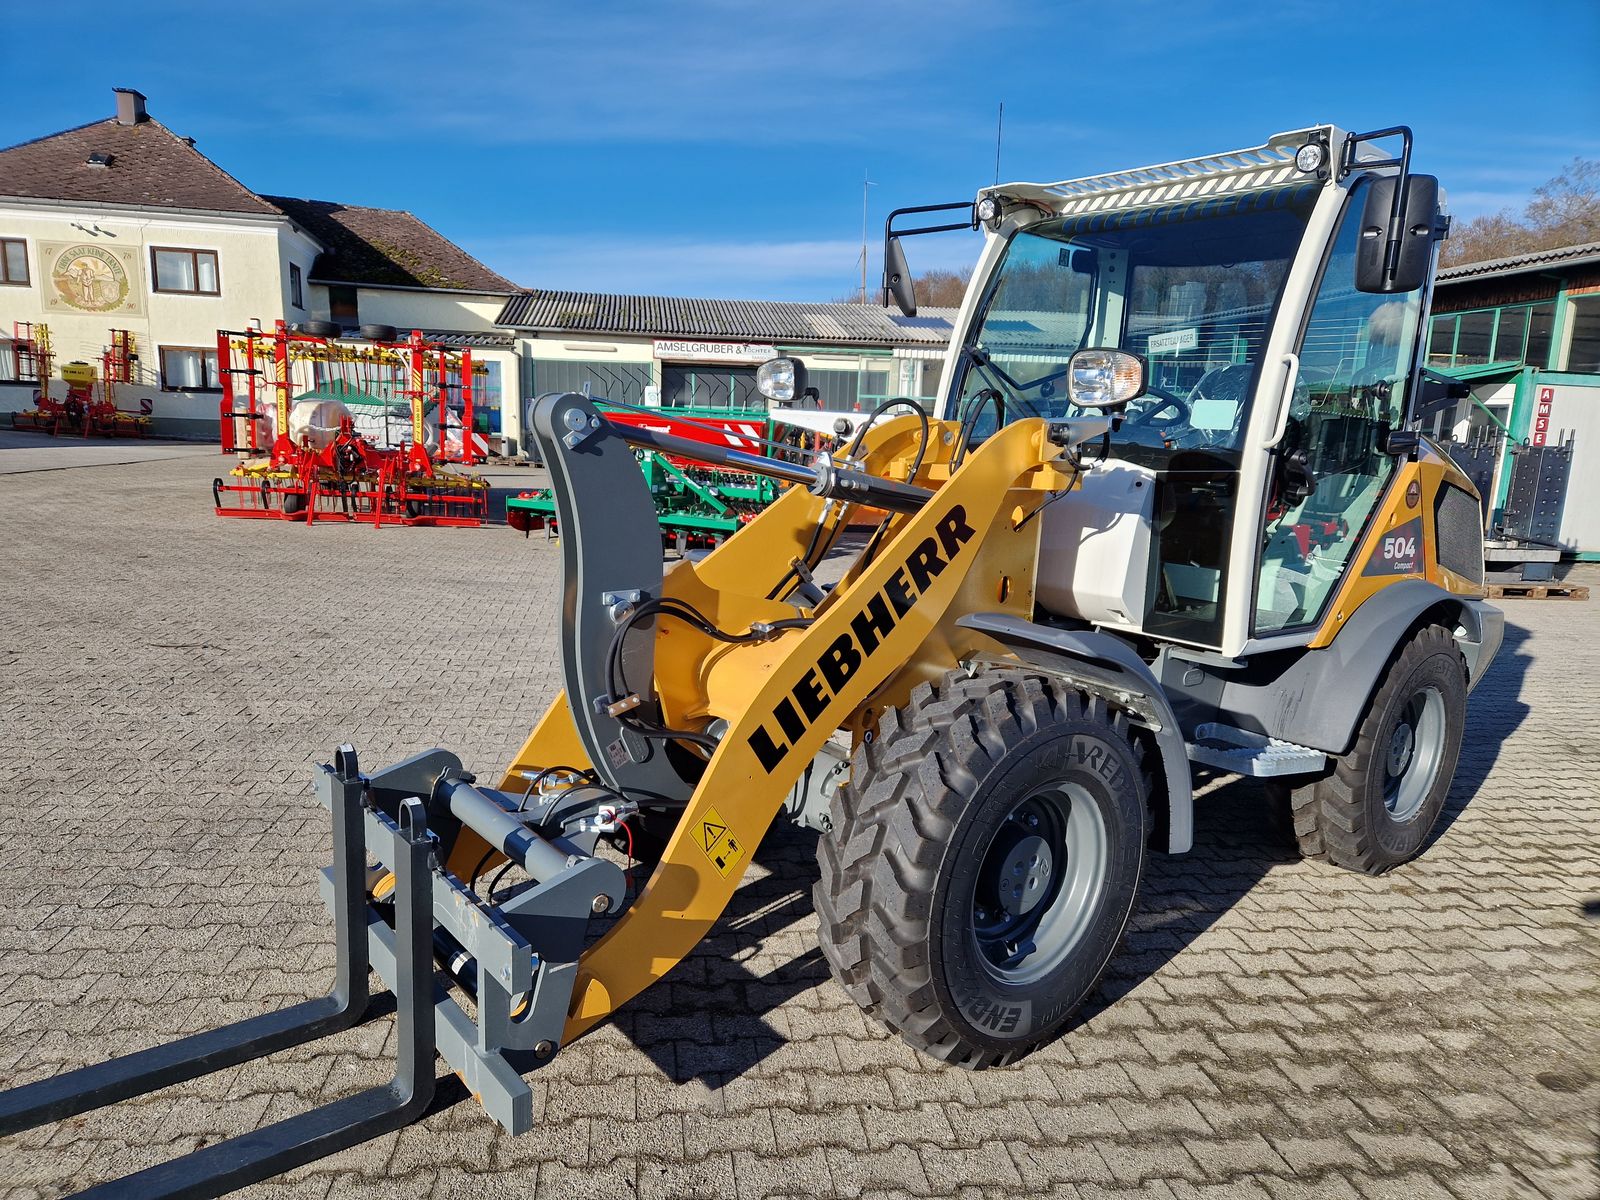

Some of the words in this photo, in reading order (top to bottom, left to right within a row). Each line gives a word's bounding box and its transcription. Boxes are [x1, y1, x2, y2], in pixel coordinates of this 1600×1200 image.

[69, 247, 86, 257] SAAT
[87, 247, 106, 259] KEINE
[656, 341, 734, 355] AMSELGRUBER
[735, 346, 742, 355] &
[1383, 537, 1416, 560] 504
[1393, 562, 1414, 571] Compact
[747, 503, 977, 775] LIEBHERR
